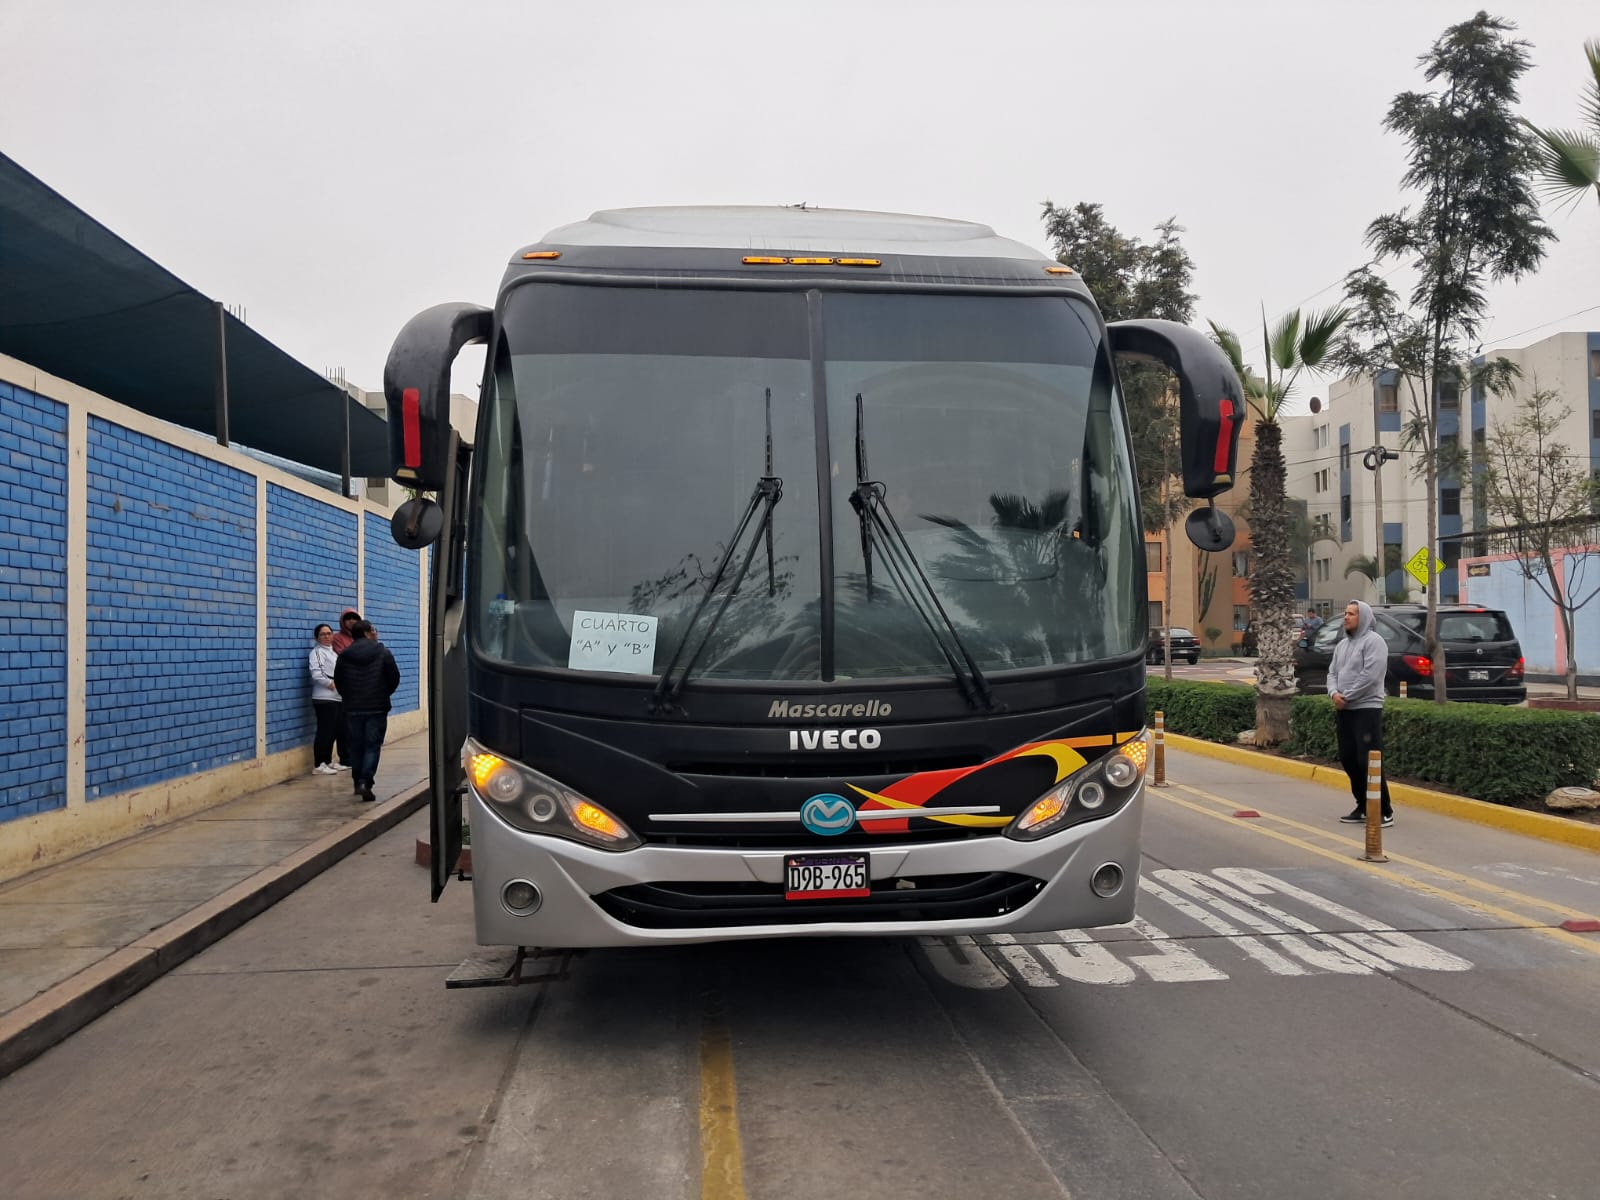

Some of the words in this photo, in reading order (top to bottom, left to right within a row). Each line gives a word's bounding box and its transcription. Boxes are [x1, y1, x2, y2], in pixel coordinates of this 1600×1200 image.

[580, 618, 650, 633] CUARTO
[768, 700, 892, 718] Mascarello
[789, 729, 882, 750] IVECO
[790, 864, 866, 891] D9B-965
